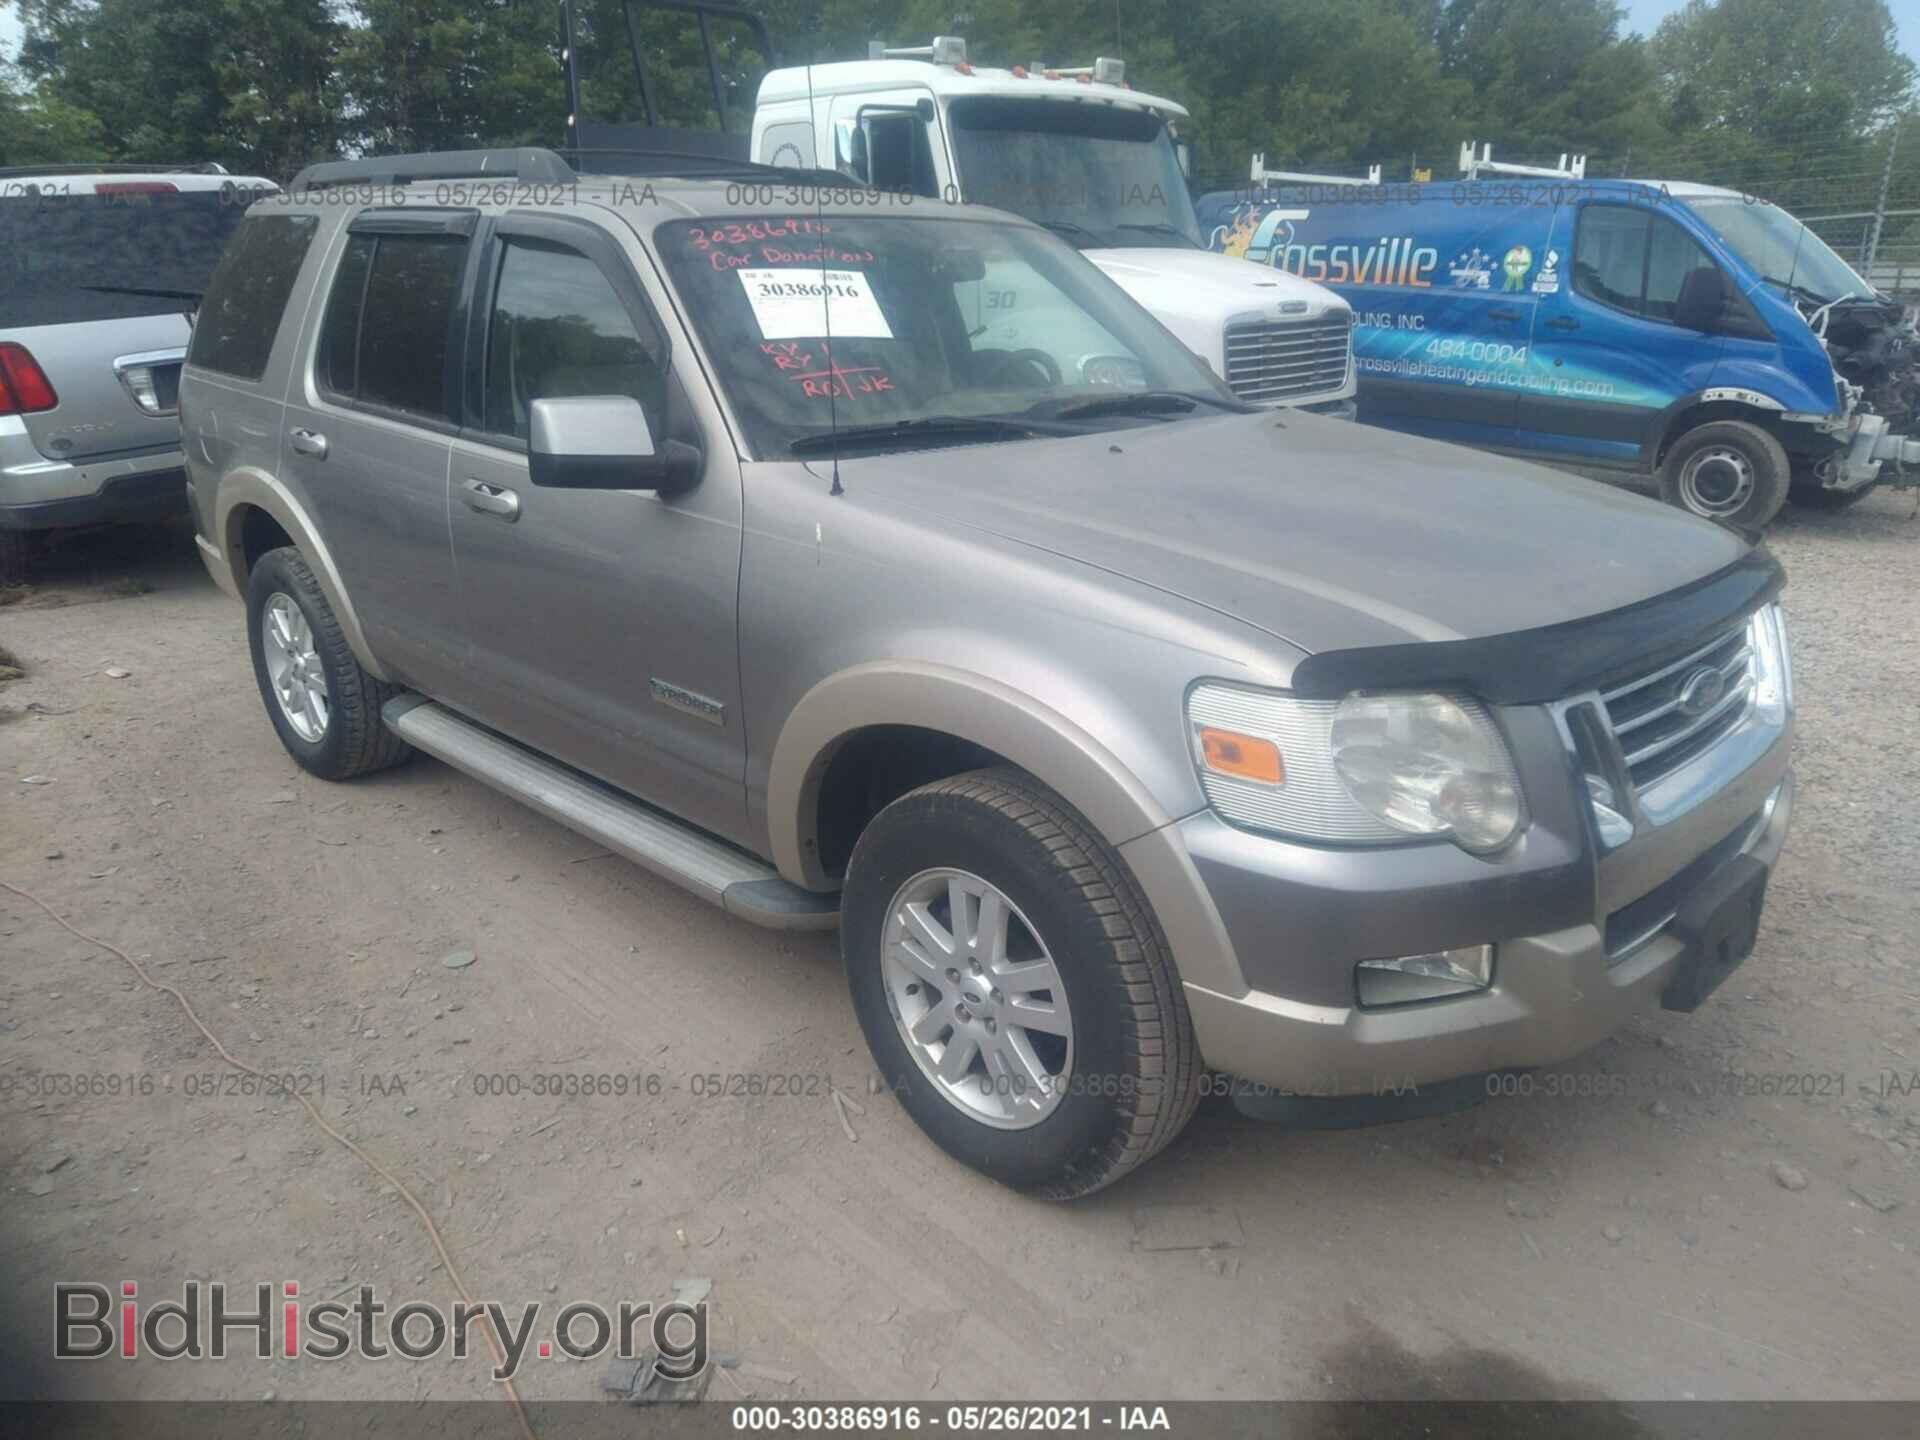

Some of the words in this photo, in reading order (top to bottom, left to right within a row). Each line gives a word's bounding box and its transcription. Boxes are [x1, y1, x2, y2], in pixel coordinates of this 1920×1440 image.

[710, 250, 751, 272] Car
[758, 282, 859, 298] 30386916
[985, 290, 1017, 309] 30
[1425, 337, 1528, 365] 484-0004
